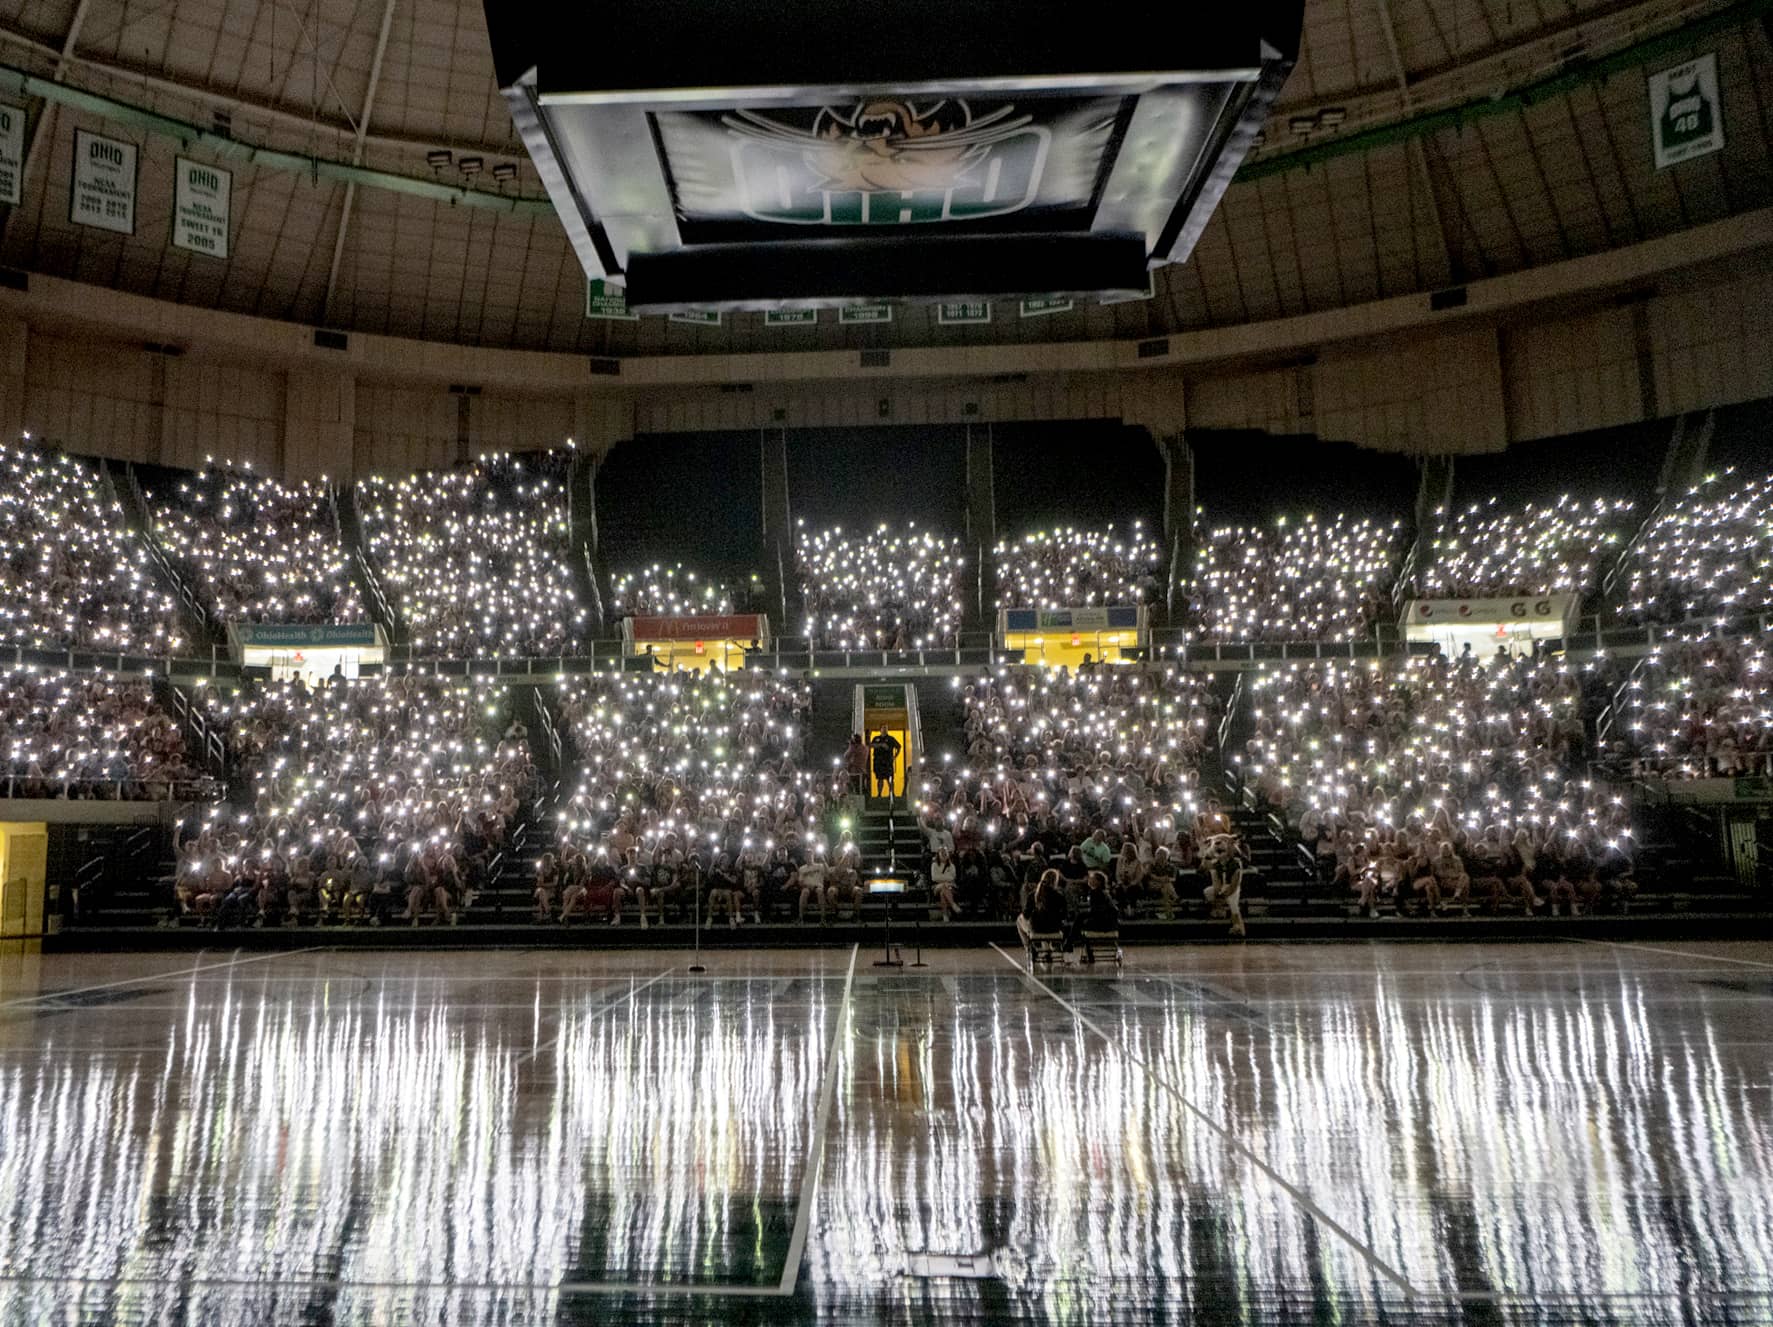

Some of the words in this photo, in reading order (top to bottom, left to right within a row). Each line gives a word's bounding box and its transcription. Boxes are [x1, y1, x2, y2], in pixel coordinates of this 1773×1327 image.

[90, 142, 123, 165] OHIO
[189, 169, 219, 192] OHIO
[181, 218, 209, 234] SWEET
[187, 233, 216, 250] 2005
[256, 631, 308, 640] OhioHealth
[326, 629, 374, 639] OhioHealth
